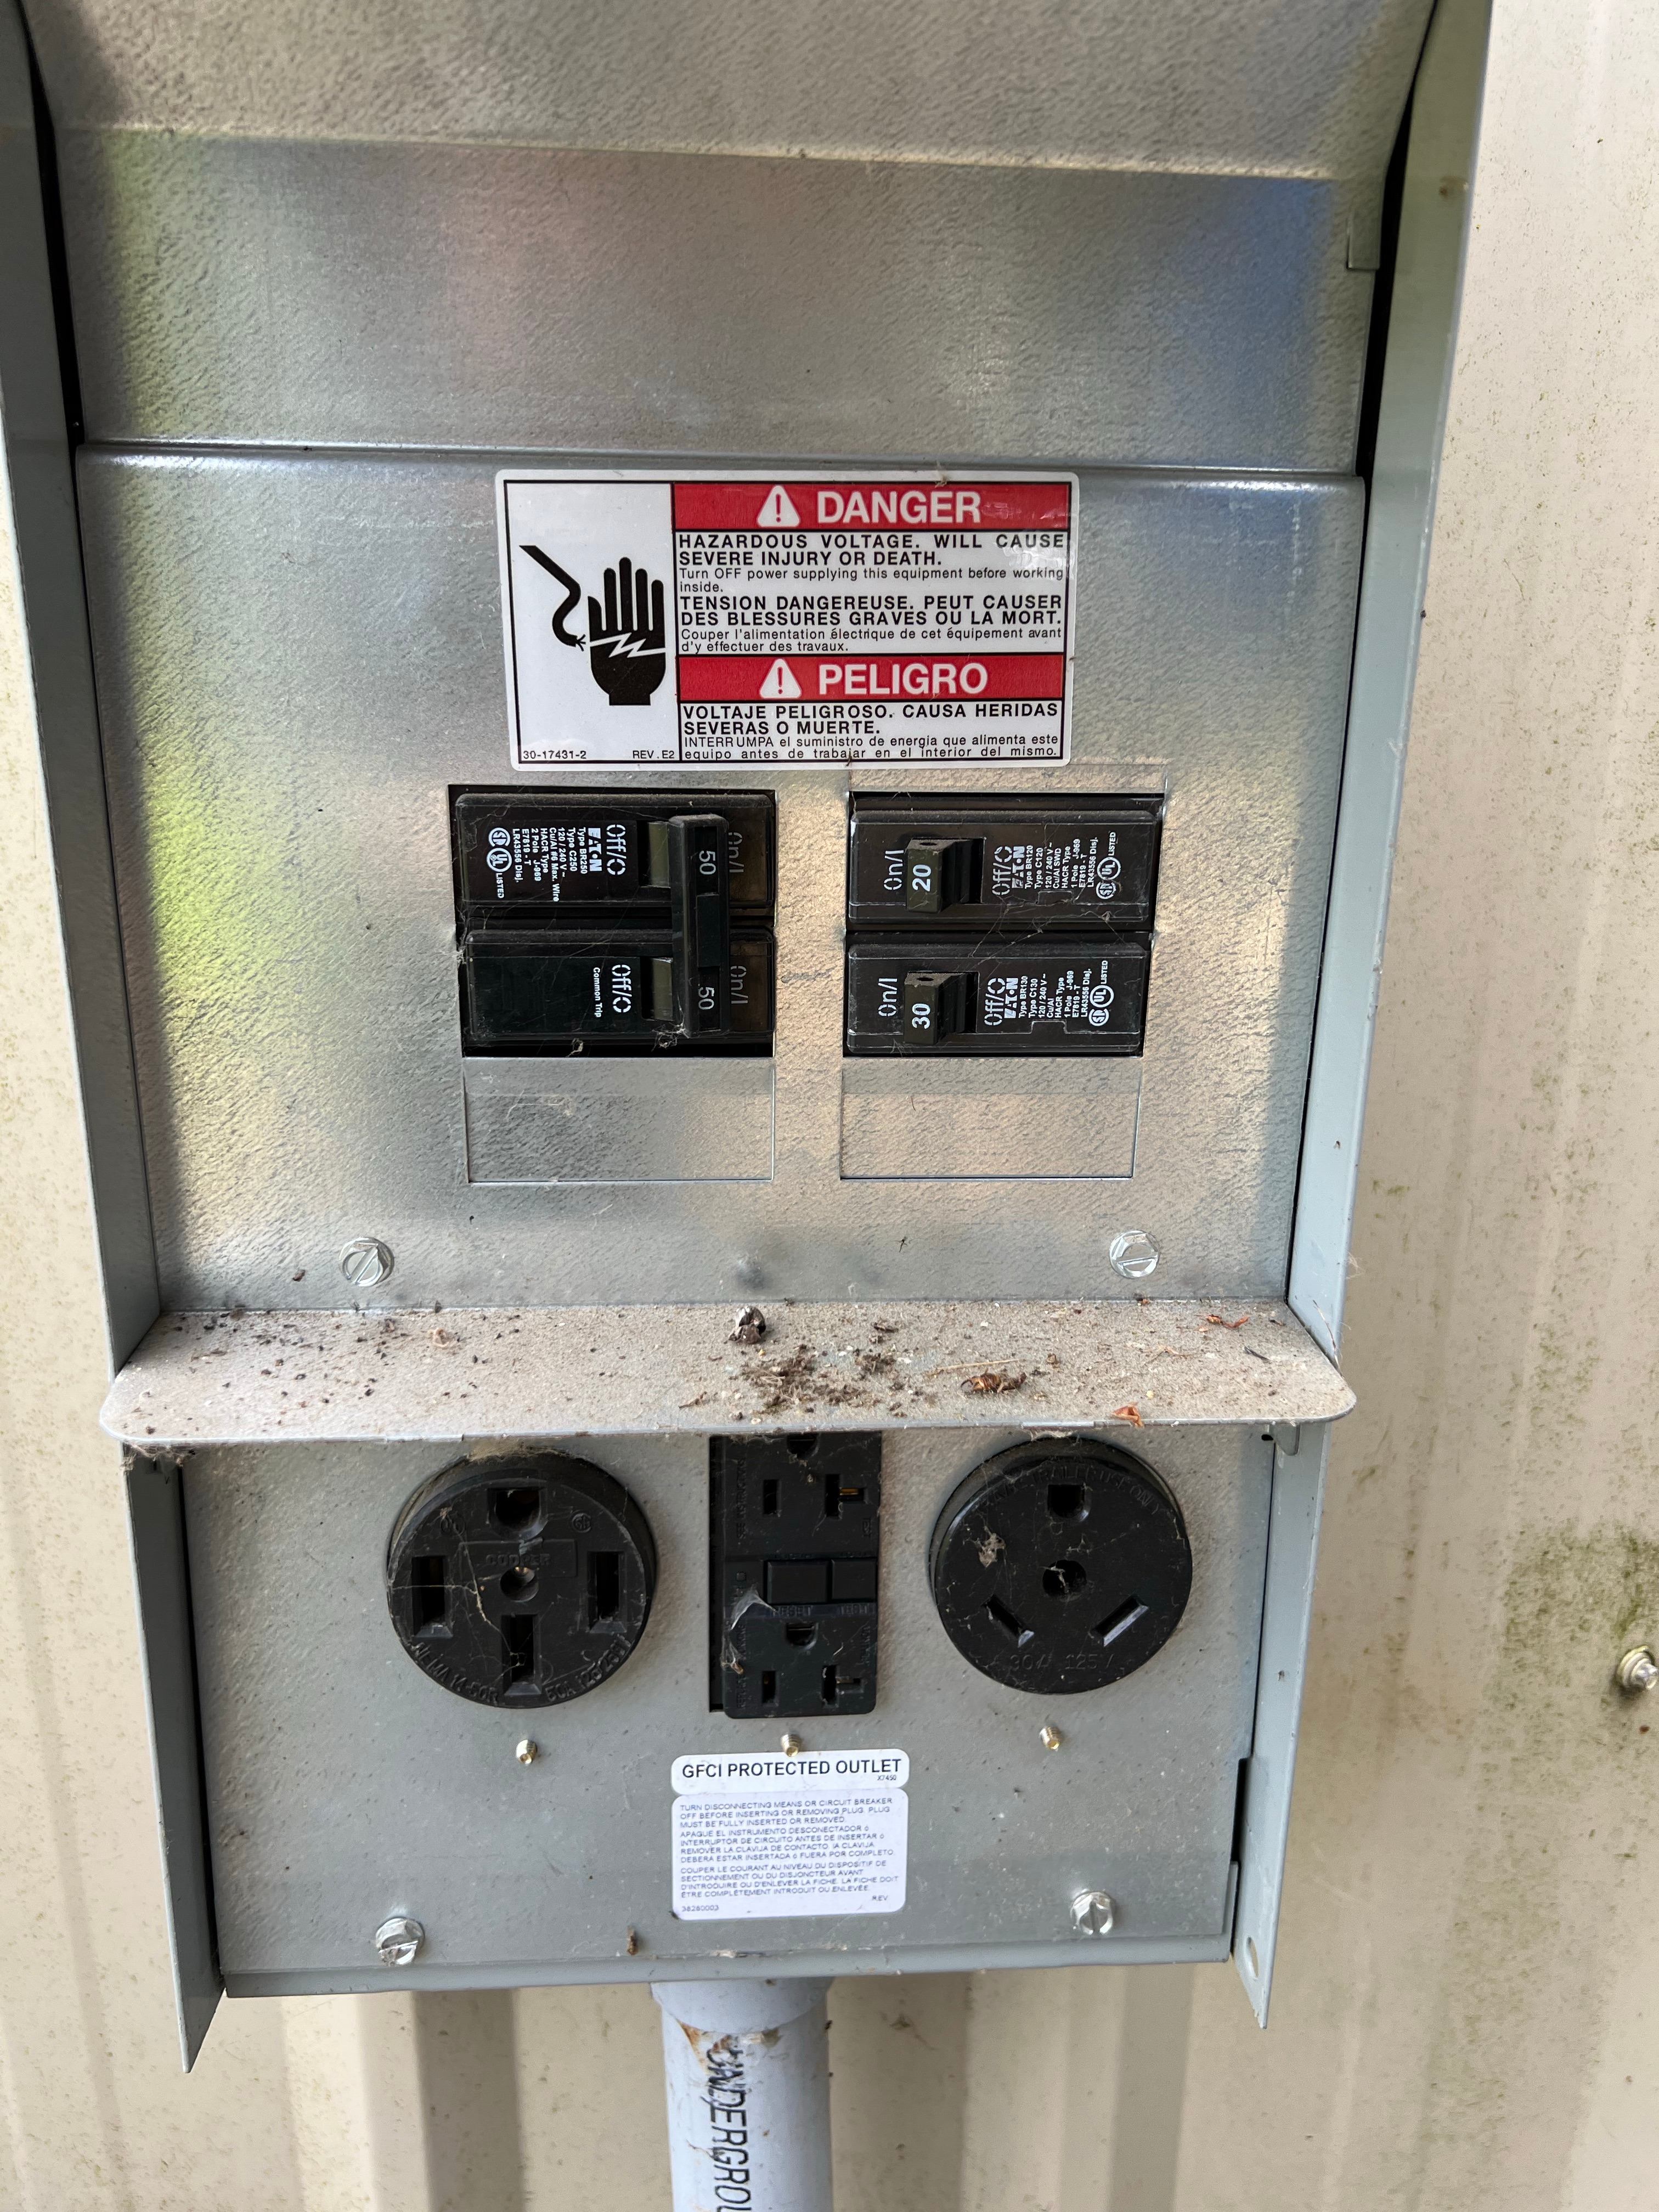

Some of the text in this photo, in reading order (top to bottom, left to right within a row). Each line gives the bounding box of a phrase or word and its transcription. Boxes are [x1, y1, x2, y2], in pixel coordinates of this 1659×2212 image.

[817, 490, 981, 524] DANGER
[680, 534, 1064, 549] HAZARDOUS VOLTAGE. WILL CAUSE
[679, 551, 942, 566] SEVERE INJURY OR DEATH.
[680, 567, 1064, 582] Turn OFF power supplying this equipment before working
[680, 582, 724, 592] inside.
[680, 595, 1062, 611] TENSION DANGEREUSE. PEUT CAUSER
[681, 611, 1062, 626] DES BLESSURES GRAVES OU LA MORT.
[681, 627, 1061, 642] Couper l'alimentation électrique de cet équipement avant
[682, 641, 849, 654] d'y effectuer des travaux.
[819, 663, 988, 696] PELIGRO
[683, 703, 1058, 719] VOLTAJE PELIGROSO. CAUSA HERIDAS
[684, 721, 880, 735] SEVERAS O MUERTE.
[780, 737, 791, 747] el
[796, 736, 864, 747] suministro
[869, 736, 884, 746] de
[943, 737, 967, 747] que
[972, 735, 1026, 746] alimenta
[1031, 735, 1058, 744] este
[523, 750, 587, 759] 30-17431-2
[685, 749, 732, 761] equipo
[741, 749, 778, 759] antes
[788, 748, 804, 759] de
[814, 748, 865, 760] trabajar
[900, 748, 911, 758] el
[922, 747, 972, 757] interior
[981, 747, 1001, 757] del
[1011, 747, 1057, 757] mismo.
[540, 828, 549, 873] HACR Type
[567, 827, 578, 872] Type C250
[577, 827, 588, 874] Type BR250
[1108, 832, 1116, 856] LISTED
[512, 828, 523, 883] LR43556 Disj.
[699, 850, 716, 875] 50
[1062, 846, 1071, 864] Type
[1087, 837, 1098, 888] LR43556 Disj.
[533, 860, 541, 882] J-969
[551, 862, 559, 882] Max.
[1025, 845, 1034, 889] Type BR120
[1035, 848, 1043, 889] Type C120
[495, 873, 505, 899] LISTED
[912, 864, 932, 892] 20
[1101, 960, 1109, 984] LISTED
[698, 986, 715, 1011] 50
[1018, 975, 1028, 1018] Type BR130
[1054, 977, 1065, 1018] HACR Type
[594, 1002, 603, 1018] Trip
[911, 1003, 931, 1029] 30
[682, 1759, 901, 1778] GFCI PROTECTED OUTLET
[704, 1802, 772, 1811] DISCONNECTING
[736, 1810, 779, 1818] INSERTING
[796, 1808, 839, 1816] REMOVING
